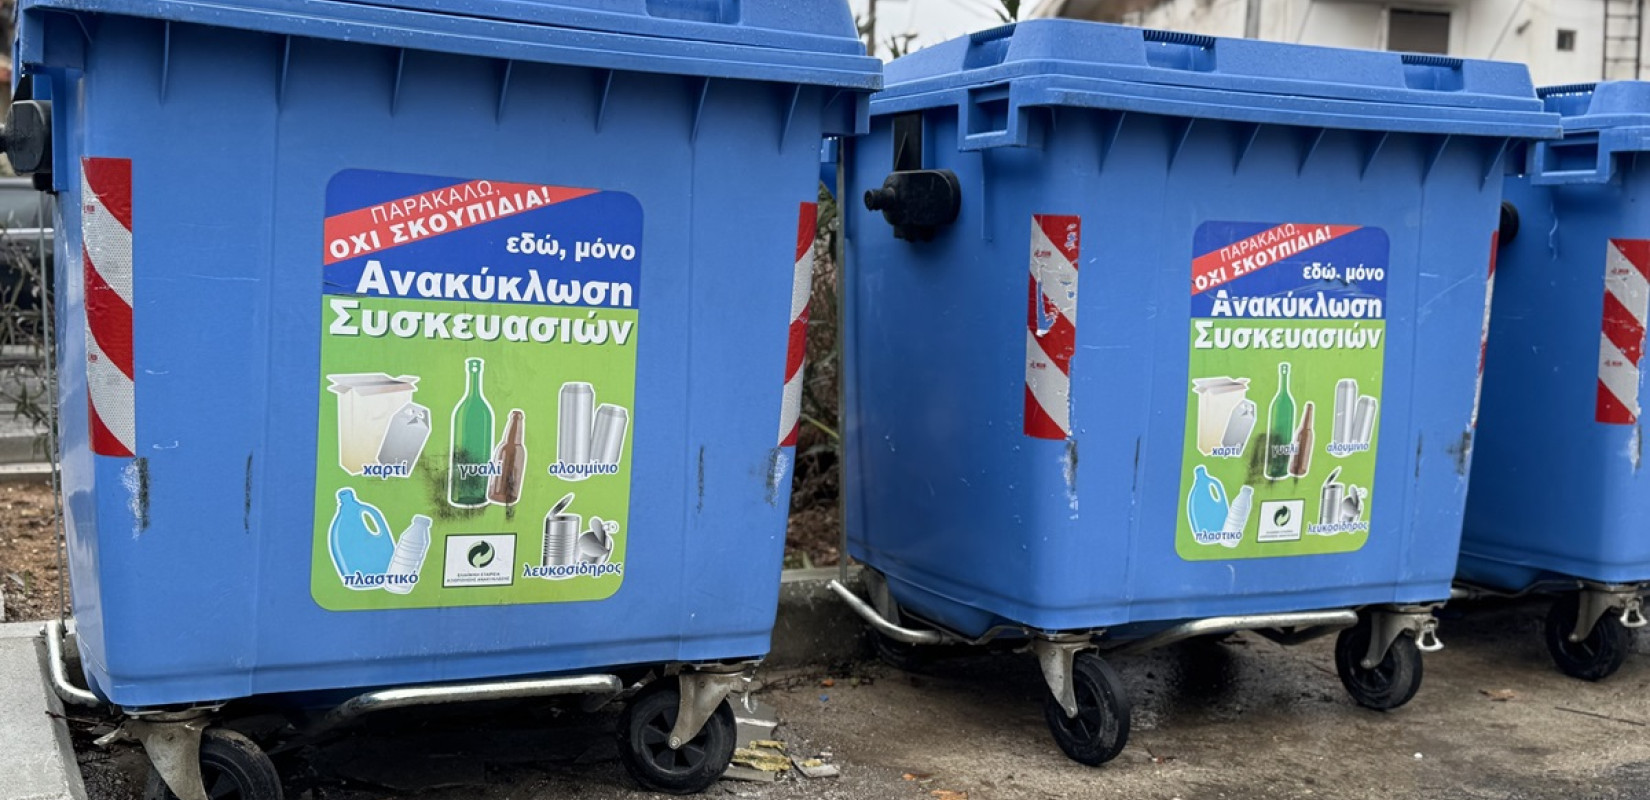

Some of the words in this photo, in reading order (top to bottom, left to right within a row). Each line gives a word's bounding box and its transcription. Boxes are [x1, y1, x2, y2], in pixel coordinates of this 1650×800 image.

[371, 180, 501, 225] ΠΑΡΑΚΑΛΩ,
[329, 229, 381, 259] ΟΧΙ
[390, 186, 551, 244] ΣΚΟΥΠΙΔΙΑ!
[506, 232, 566, 260] εδώ,
[574, 238, 636, 261] μόνο
[1195, 266, 1227, 290] ΟΧΙ
[1231, 225, 1332, 276] ΣΚΟΥΠΙΔΙΑ!
[1220, 223, 1300, 263] ΠΑΡΑΚΑΛΩ,
[356, 260, 632, 307] Ανακύκλωση
[1345, 264, 1384, 282] μόνο
[1211, 290, 1382, 318] Ανακύκλωση
[329, 299, 634, 345] Συσκευασιών
[1194, 320, 1382, 349] Συσκευασιών
[362, 461, 408, 480] χαρτί
[459, 461, 502, 480] γυαλί
[549, 461, 618, 478] αλουμίνιο
[344, 571, 419, 588] πλαστικό
[523, 561, 622, 579] λευκοσίδηρος
